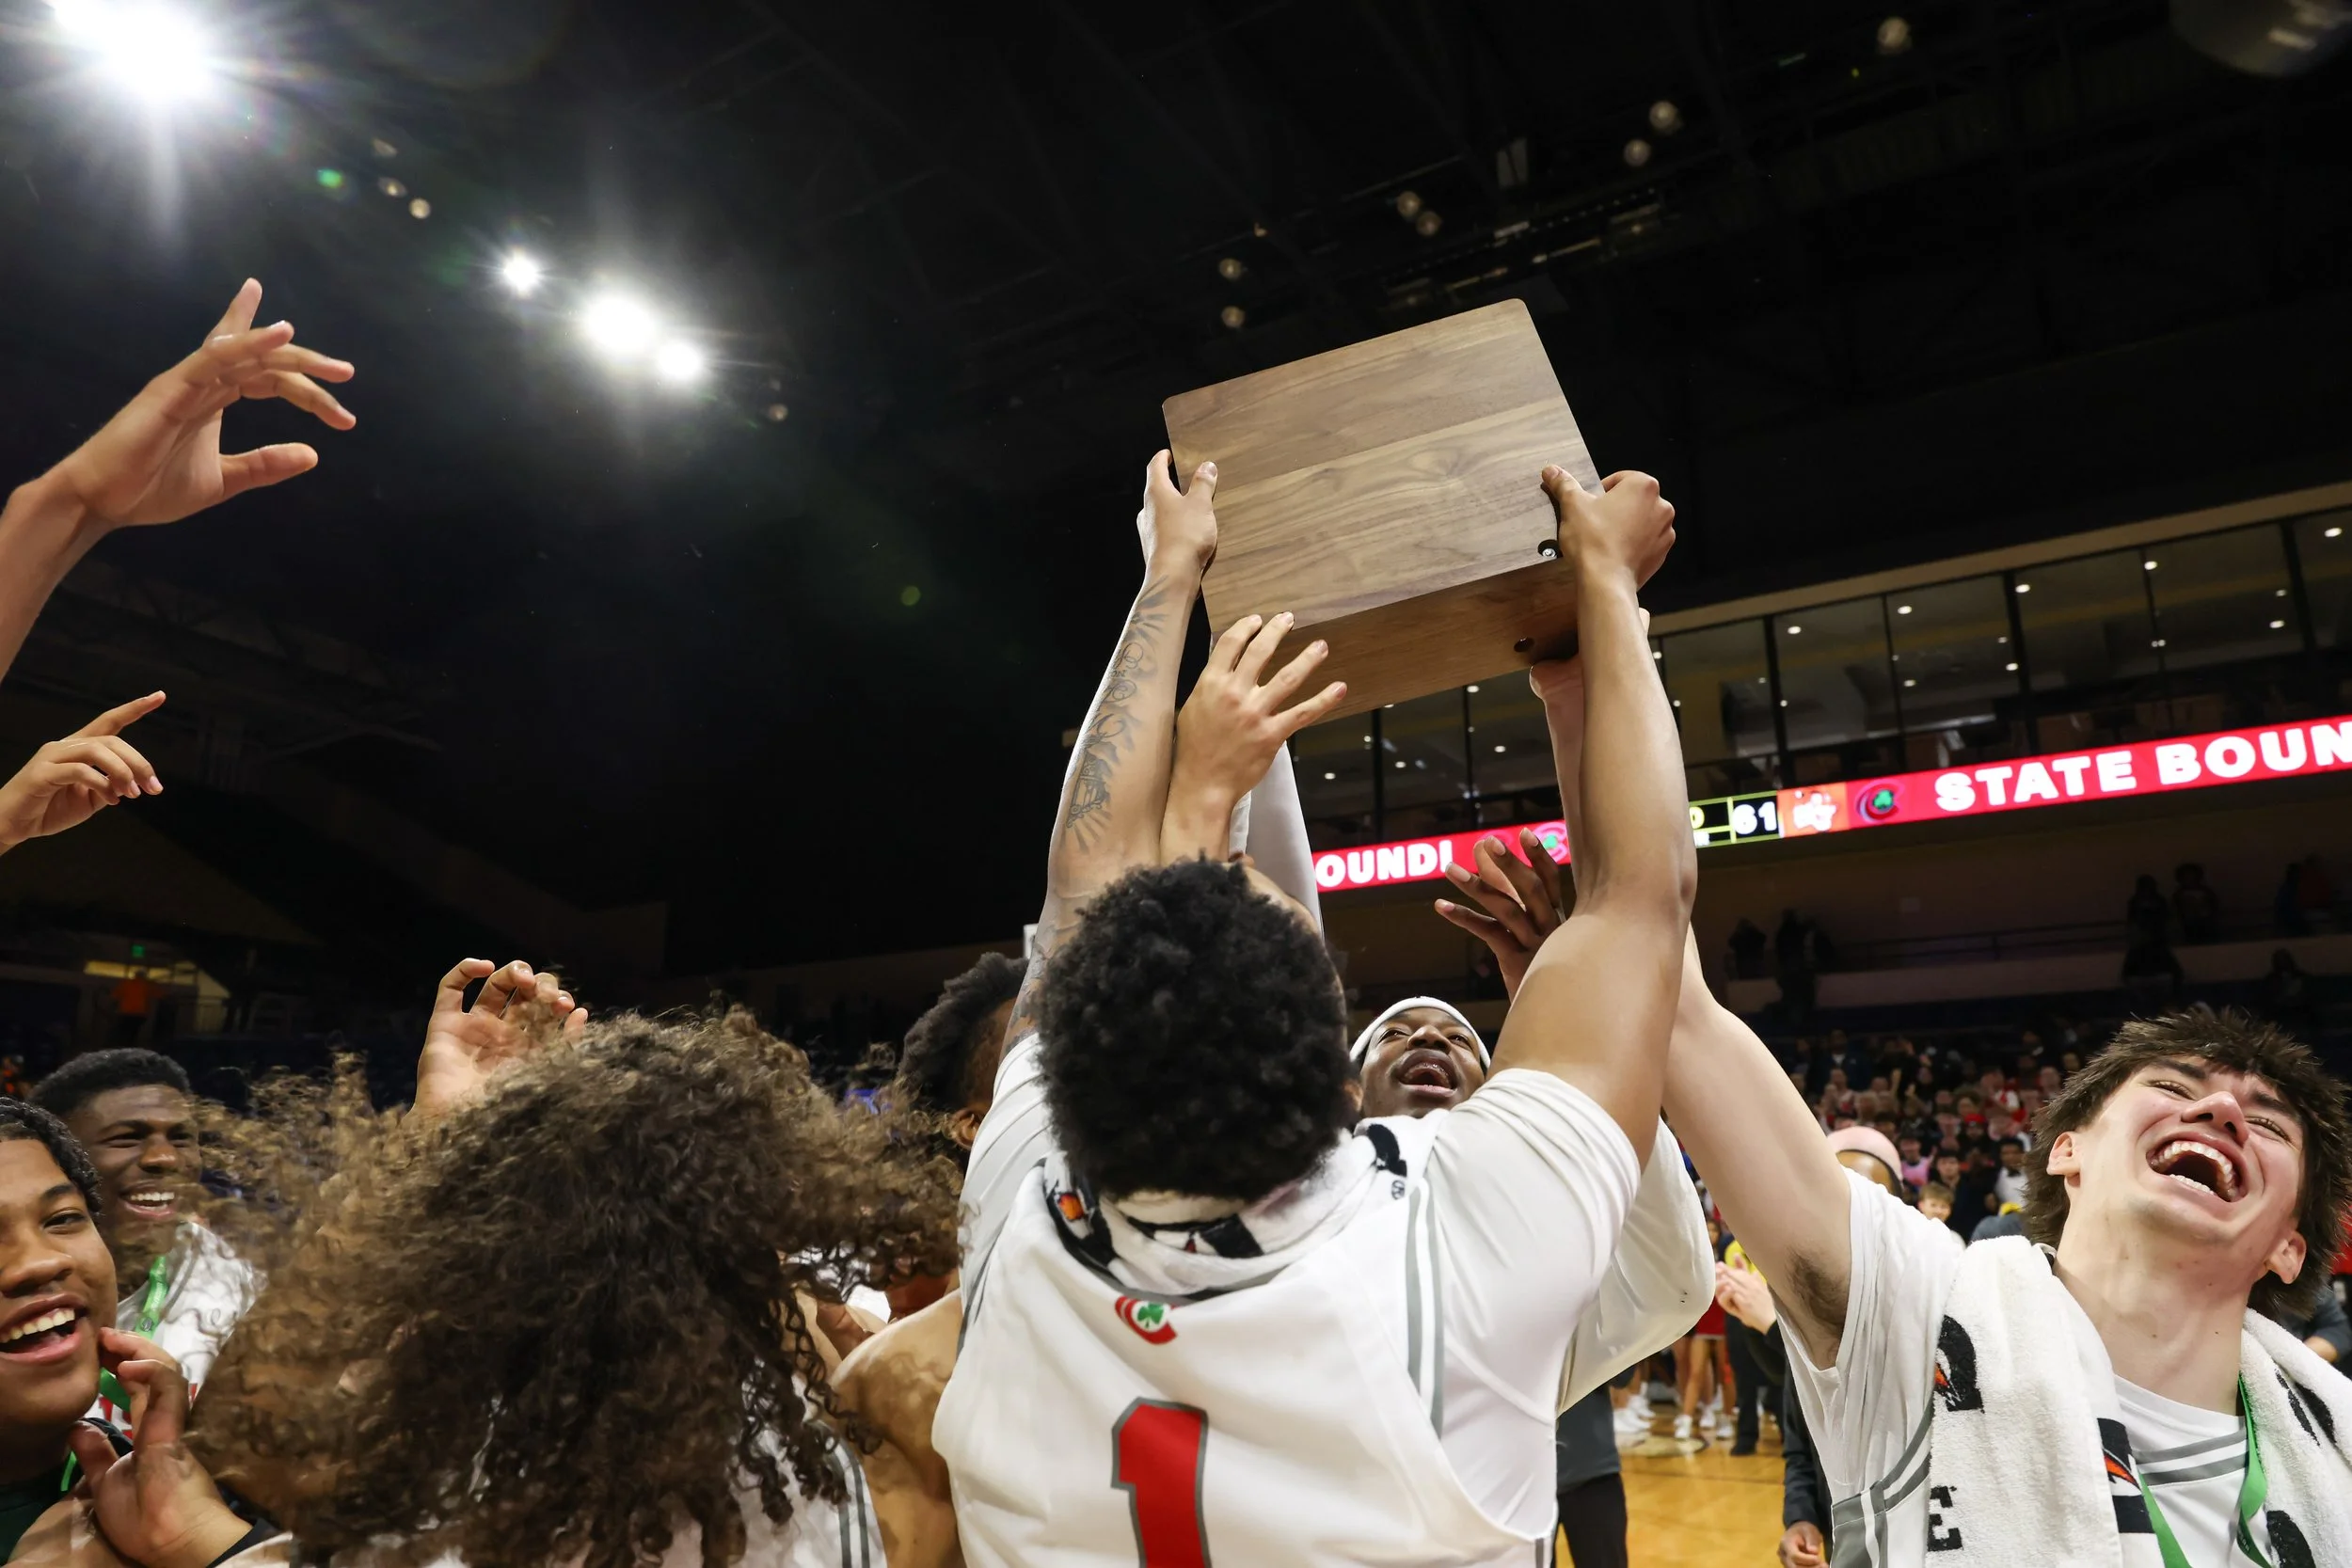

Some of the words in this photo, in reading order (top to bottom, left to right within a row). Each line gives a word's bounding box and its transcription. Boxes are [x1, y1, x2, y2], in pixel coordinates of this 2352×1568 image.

[1934, 750, 2137, 812] STATE
[1732, 801, 1778, 835] 61
[1111, 1397, 1211, 1568] 1
